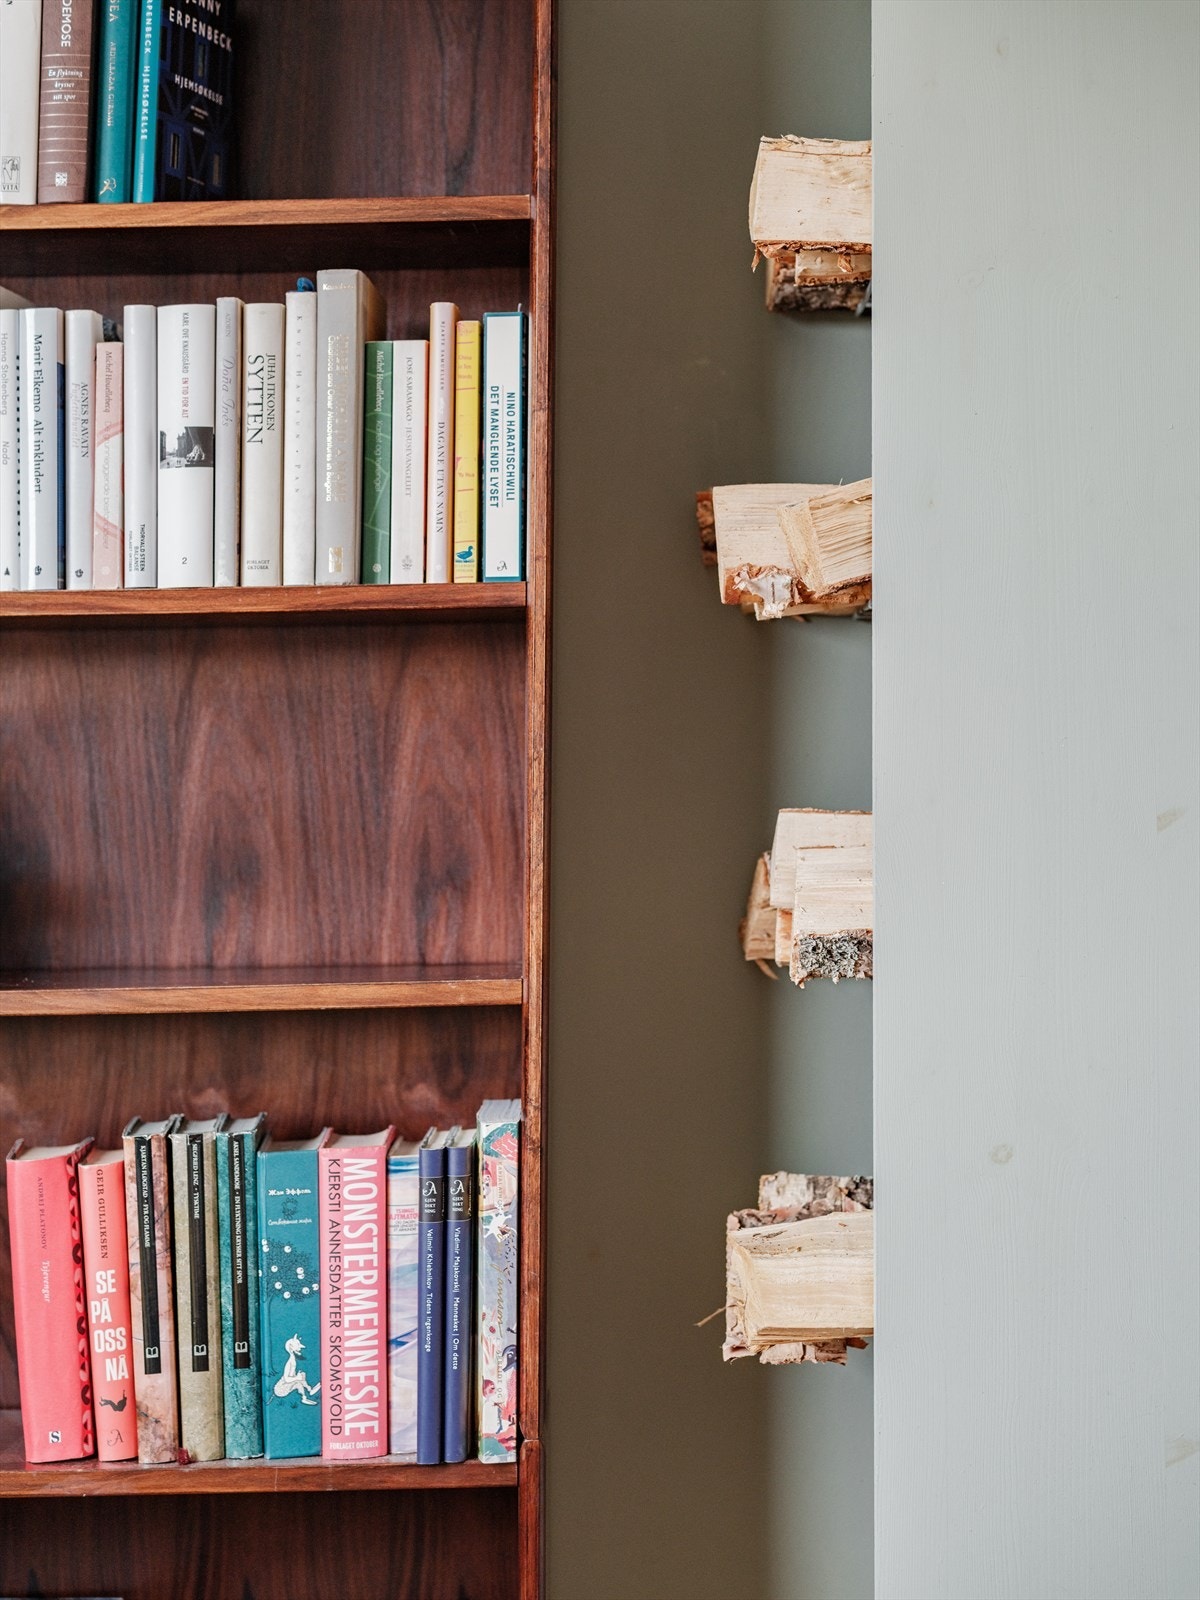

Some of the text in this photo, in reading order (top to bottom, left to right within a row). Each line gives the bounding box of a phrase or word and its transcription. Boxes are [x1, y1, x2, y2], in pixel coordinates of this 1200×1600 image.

[61, 0, 72, 48] DEMOSE
[169, 6, 232, 52] ERPENBECK
[140, 66, 151, 140] HJEMSØKELSE
[174, 73, 224, 105] HJEMSØKELSE
[103, 351, 113, 413] Michel Houellebecq
[181, 312, 191, 419] KARL OVE KNAUSGÅRD EN TID FOR ALT
[374, 350, 385, 412] Michel Houellebecq
[0, 364, 10, 415] Stoltenberg
[221, 355, 235, 428] Doña Inés
[246, 354, 265, 445] SYTTEN
[265, 353, 276, 431] JUHA ITKONEN
[405, 376, 413, 421] SARAMAGO
[33, 334, 45, 494] Marit Eikemo Alt inkludert
[80, 382, 89, 458] AGNES RAVATN
[404, 427, 412, 497] JESUSEVANGELIET
[489, 385, 500, 508] DET MANGLENDE LYSET
[506, 392, 516, 501] NINO HARATISCHWILI
[436, 422, 446, 533] DAGANE UTAN NAMN
[181, 557, 188, 565] 2
[140, 1145, 148, 1169] KJARTAN
[192, 1143, 200, 1170] SIEGFRIED
[233, 1140, 241, 1157] AKSEL
[141, 1170, 149, 1198] FLØGSTAD
[192, 1171, 200, 1185] LENZ
[38, 1177, 48, 1250] ANDREJ PLATONOV
[96, 1169, 109, 1259] GEIR GULLIKSEN
[142, 1203, 150, 1215] FYR
[234, 1196, 241, 1204] EN
[235, 1235, 243, 1257] KRYSSER
[426, 1229, 434, 1251] Velimir
[41, 1260, 51, 1303] Tsjevengur
[95, 1270, 117, 1295] SE
[426, 1254, 434, 1289] Khlebnikov
[452, 1256, 461, 1292] Majakovskij
[90, 1298, 114, 1324] PÅ
[329, 1158, 343, 1436] KJERSTI ANNESDATTER SKOMSVOLD
[344, 1158, 380, 1436] MONSTERMENNESKE
[453, 1297, 461, 1331] Mennesket
[93, 1327, 127, 1353] OSS
[424, 1317, 433, 1352] ingenkonge
[452, 1338, 460, 1351] Om
[104, 1353, 130, 1382] NÅ
[452, 1353, 460, 1370] dette
[329, 1440, 379, 1450] FORLAGET OKTOBER
